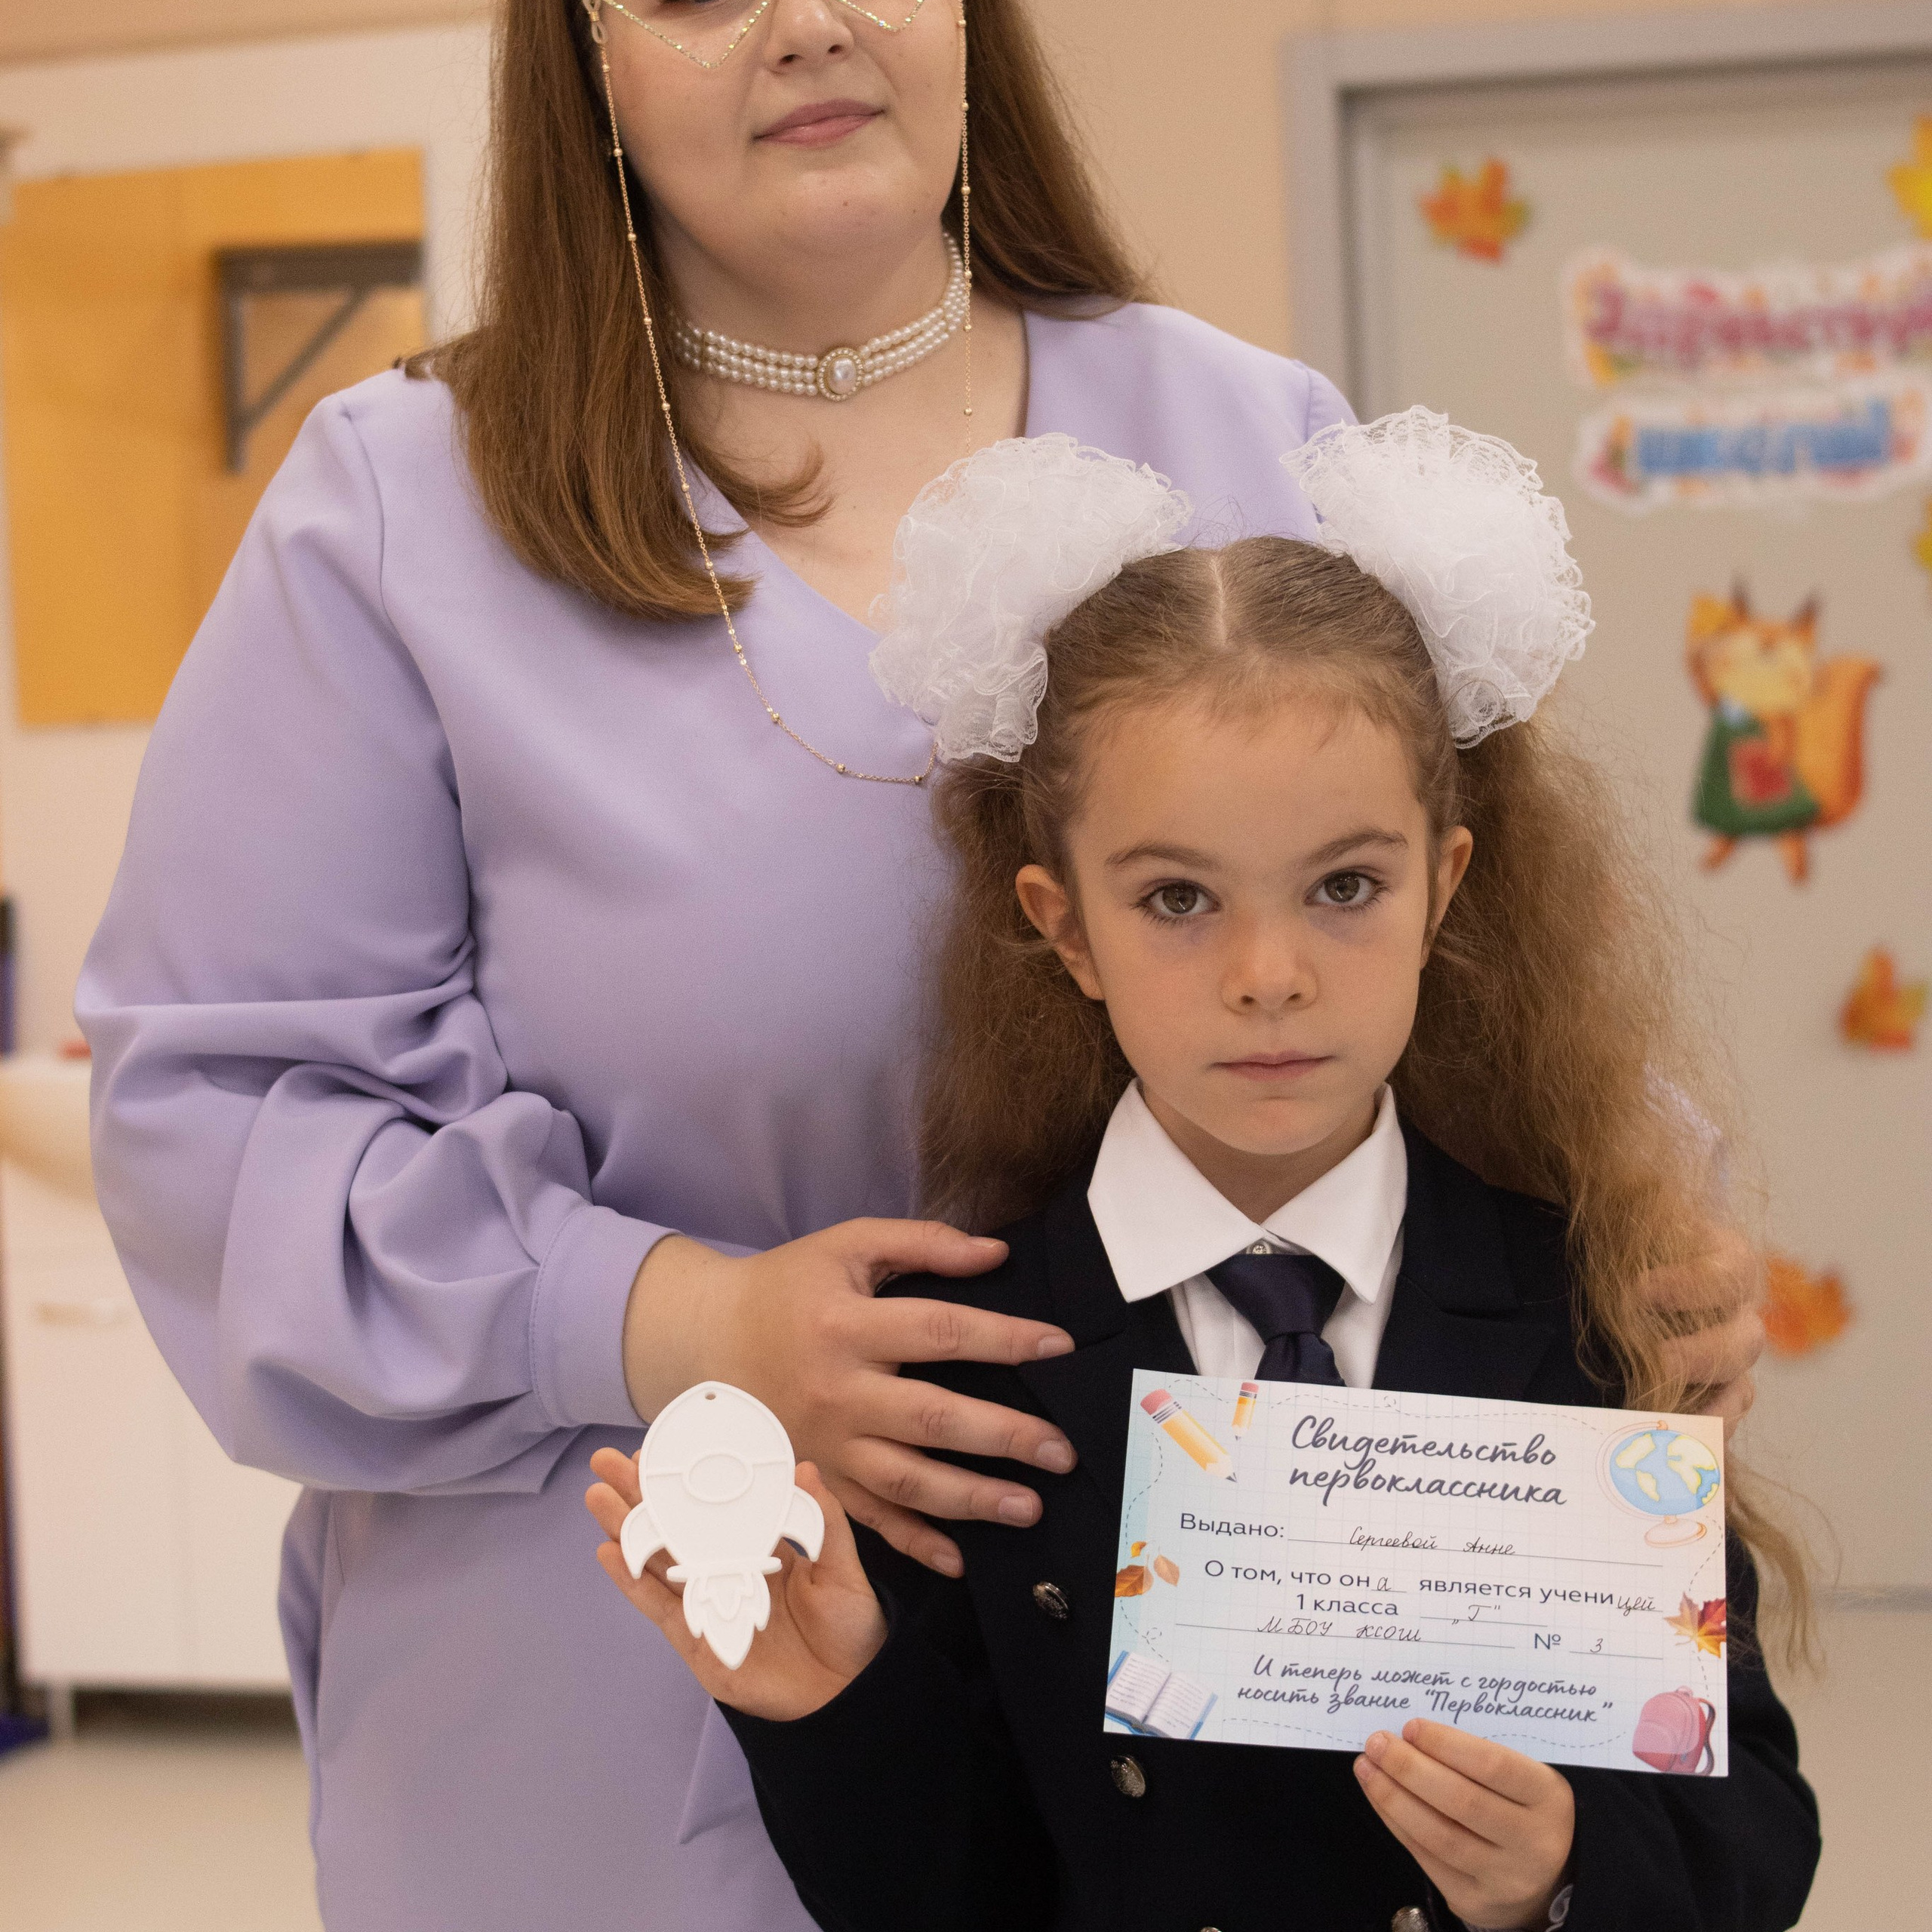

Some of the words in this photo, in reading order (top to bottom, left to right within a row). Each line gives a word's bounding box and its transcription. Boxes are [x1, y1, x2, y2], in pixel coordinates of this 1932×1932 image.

[1291, 1414, 1557, 1470] Свидетельство
[1289, 1457, 1567, 1506] первоклассника
[1180, 1512, 1284, 1538] Выдано:
[1349, 1526, 1438, 1551] Сергеевой
[1463, 1537, 1515, 1555] Анне
[1204, 1559, 1224, 1577] О
[1231, 1565, 1282, 1585] том,
[1291, 1570, 1331, 1586] что
[1420, 1579, 1531, 1598] является
[1296, 1593, 1305, 1611] 1
[1313, 1598, 1399, 1616] класса
[1534, 1632, 1561, 1651] №
[1589, 1638, 1604, 1654] 3
[1237, 1687, 1319, 1704] носить
[1327, 1684, 1411, 1714] звание
[1254, 1654, 1274, 1677] И
[1281, 1663, 1362, 1692] теперь
[1371, 1669, 1455, 1686] может
[1460, 1675, 1472, 1687] с
[1478, 1676, 1597, 1703] гордостью
